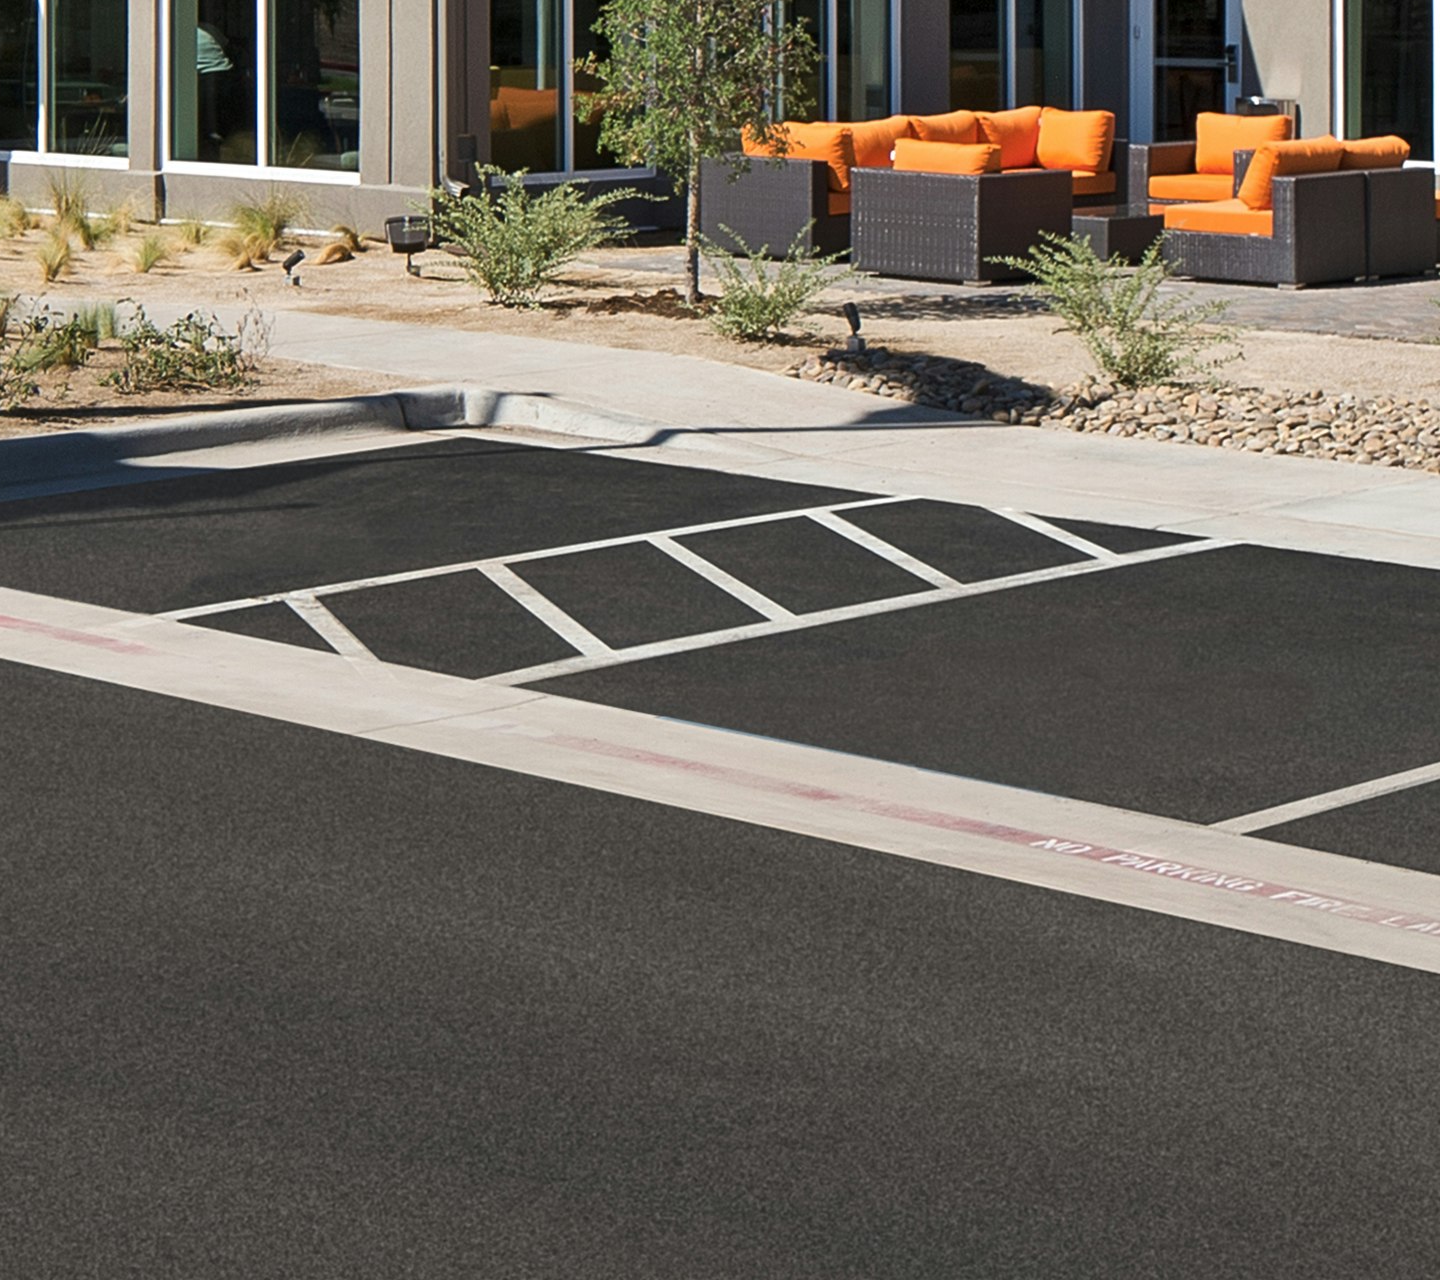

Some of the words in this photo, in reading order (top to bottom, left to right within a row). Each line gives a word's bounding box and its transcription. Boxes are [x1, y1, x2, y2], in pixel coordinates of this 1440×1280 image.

[1029, 838, 1092, 855] NO
[1101, 852, 1264, 892] PARKING
[1269, 889, 1371, 918] FIRE
